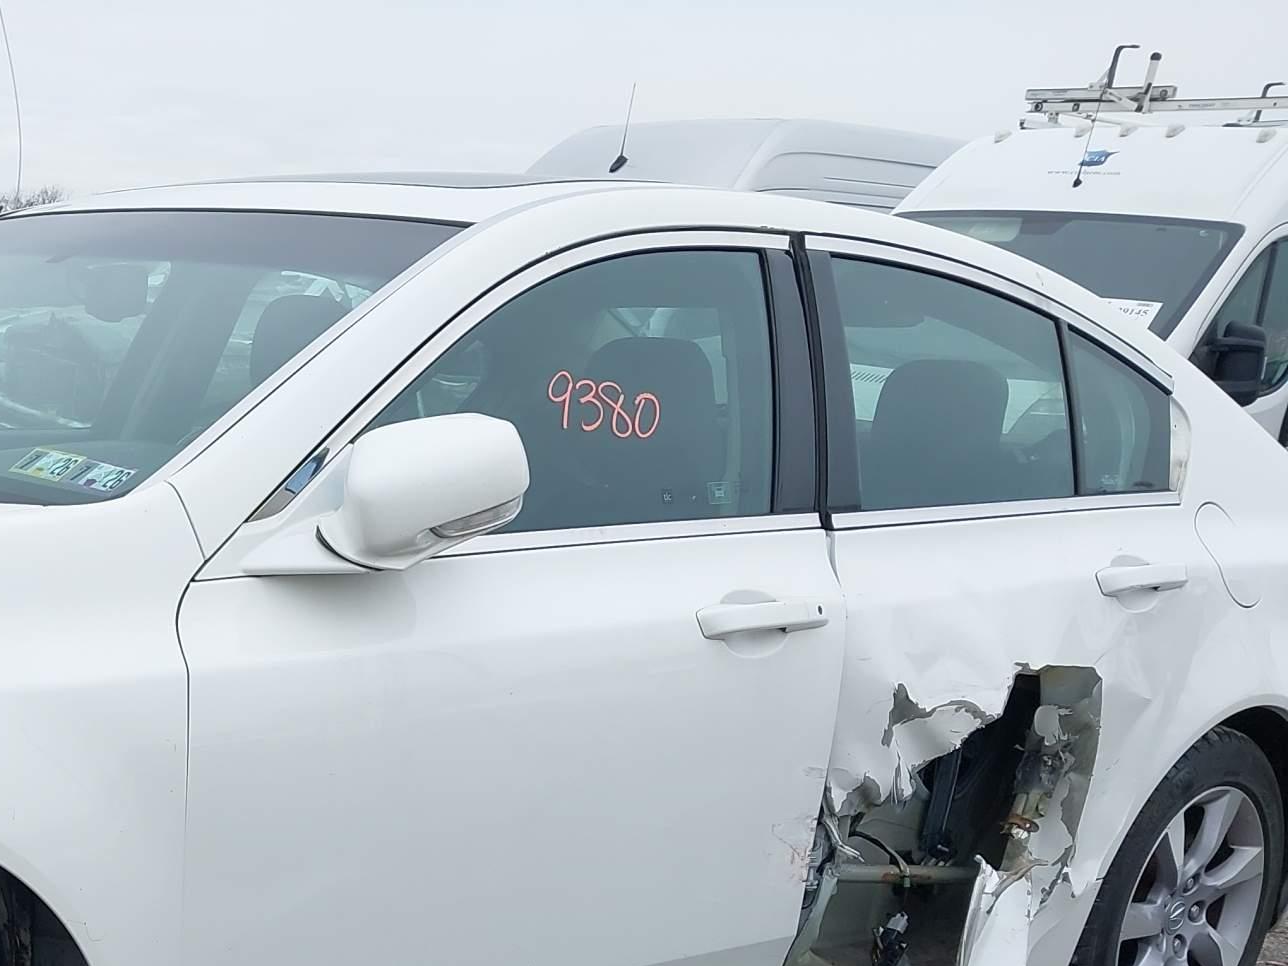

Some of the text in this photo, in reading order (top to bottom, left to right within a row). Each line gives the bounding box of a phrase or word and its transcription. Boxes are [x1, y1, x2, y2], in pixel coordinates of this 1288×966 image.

[548, 370, 660, 438] 9380
[50, 457, 79, 477] 26
[102, 470, 131, 490] 26
